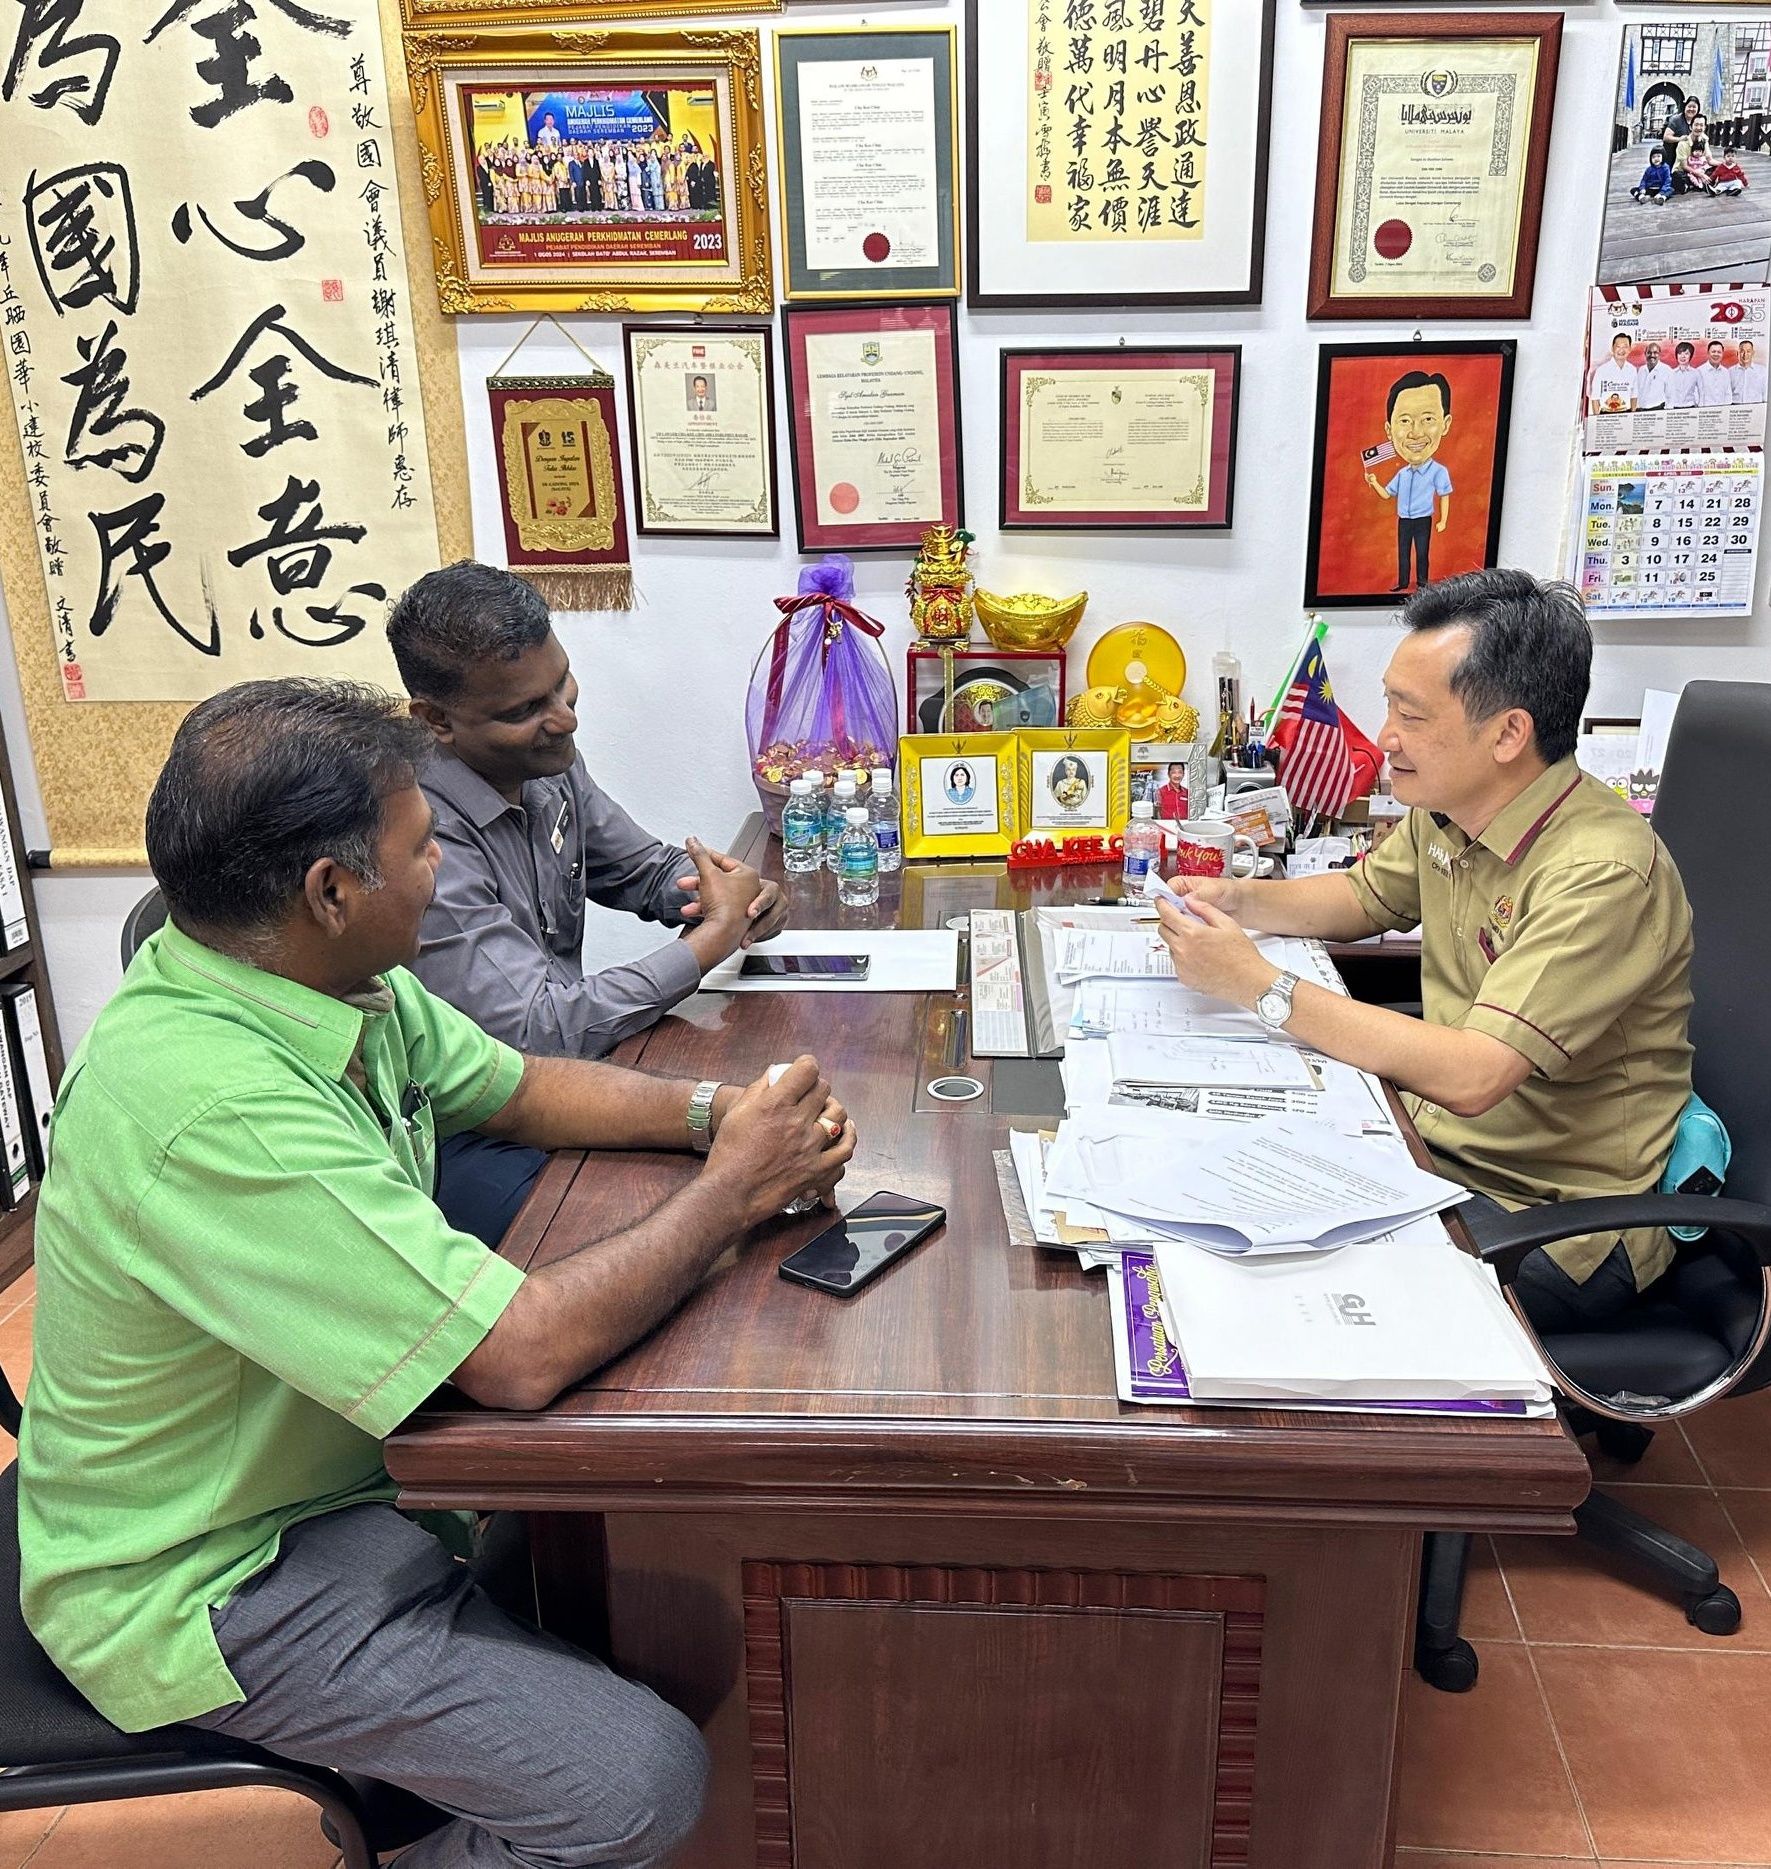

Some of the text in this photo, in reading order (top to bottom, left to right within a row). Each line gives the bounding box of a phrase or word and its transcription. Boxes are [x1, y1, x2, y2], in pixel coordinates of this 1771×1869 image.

[565, 105, 615, 117] MAJLIS
[631, 124, 654, 133] 2023
[519, 231, 723, 250] MAJLIS ANUGERAH PERKHIDMATAN CEMERLANG 2023
[1710, 302, 1767, 324] 2025
[2, 0, 222, 658] 為國為民
[143, 0, 388, 650] 全心全意
[1593, 483, 1615, 492] Sun.
[1590, 498, 1751, 511] Mon. 7 14 21 28
[1591, 516, 1749, 529] Tue. 8 15 22 29
[1587, 538, 1611, 547] Wed.
[1651, 537, 1659, 546] 9
[1676, 536, 1692, 546] 16
[1702, 535, 1719, 545] 23
[1731, 535, 1747, 545] 30
[1587, 553, 1717, 565] Thu. 3 10 17 24
[1588, 575, 1604, 583] Fri.
[1644, 573, 1659, 583] 11
[1699, 572, 1716, 581] 25
[1585, 592, 1604, 601] Sat.
[1010, 837, 1058, 859] CHA
[1062, 834, 1105, 857] KEE
[6, 866, 16, 888] DAP
[5, 1080, 13, 1100] DAP
[1146, 1320, 1179, 1377] Persatuan
